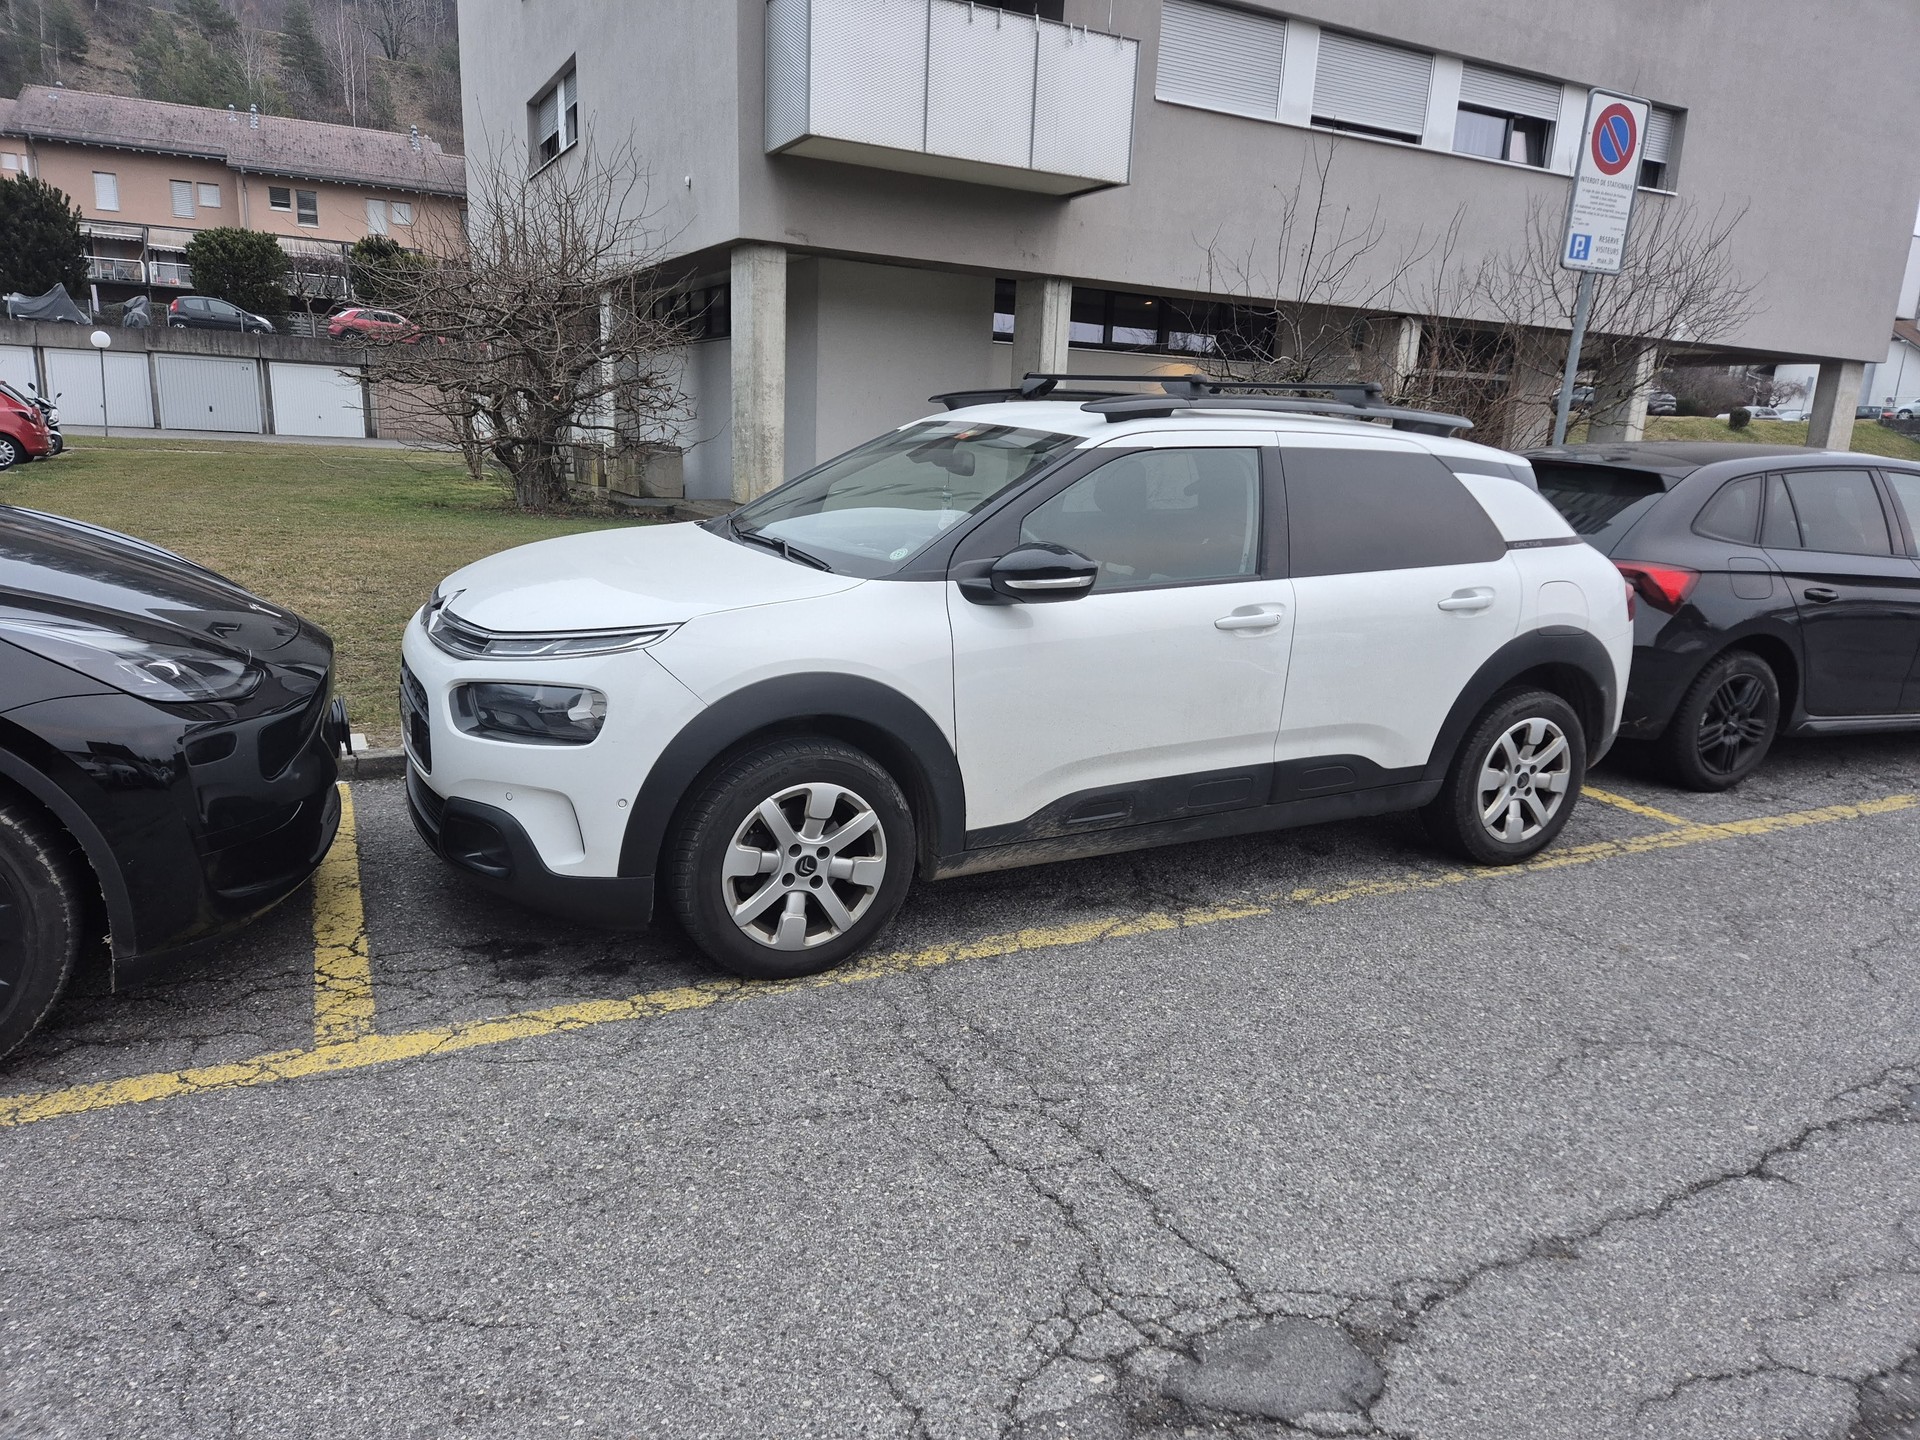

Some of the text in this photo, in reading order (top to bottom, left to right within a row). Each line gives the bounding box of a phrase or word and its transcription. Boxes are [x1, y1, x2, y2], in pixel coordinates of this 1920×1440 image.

[1580, 176, 1600, 185] INTERDIT
[1607, 180, 1633, 190] STATIONNER
[1595, 246, 1619, 256] VISITEURS
